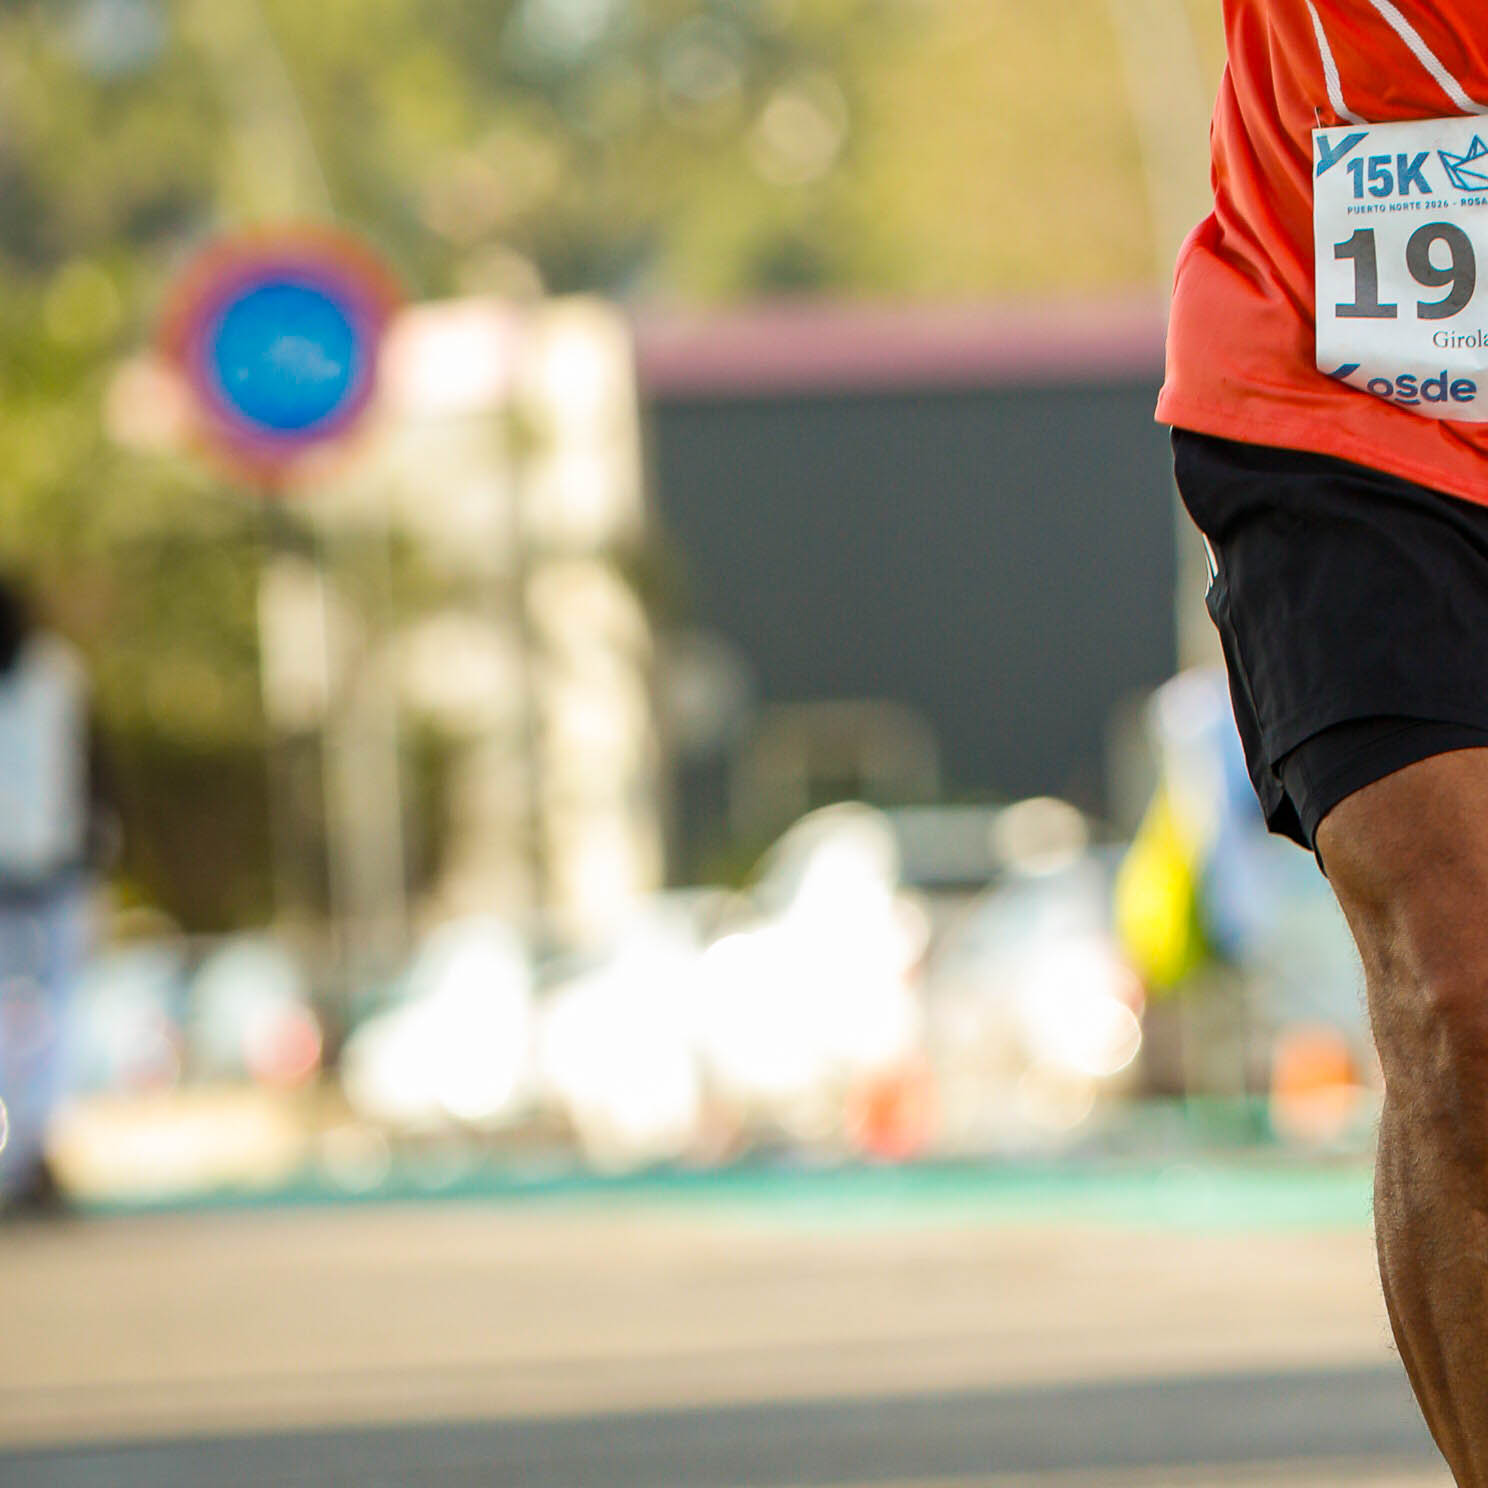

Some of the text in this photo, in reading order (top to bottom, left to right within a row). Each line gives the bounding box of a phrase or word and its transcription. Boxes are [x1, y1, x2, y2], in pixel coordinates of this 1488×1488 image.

[1346, 151, 1433, 199] 15K
[1347, 202, 1386, 215] PUERTO
[1389, 200, 1421, 213] NORTE
[1425, 199, 1449, 210] 2026
[1367, 369, 1478, 405] osde
